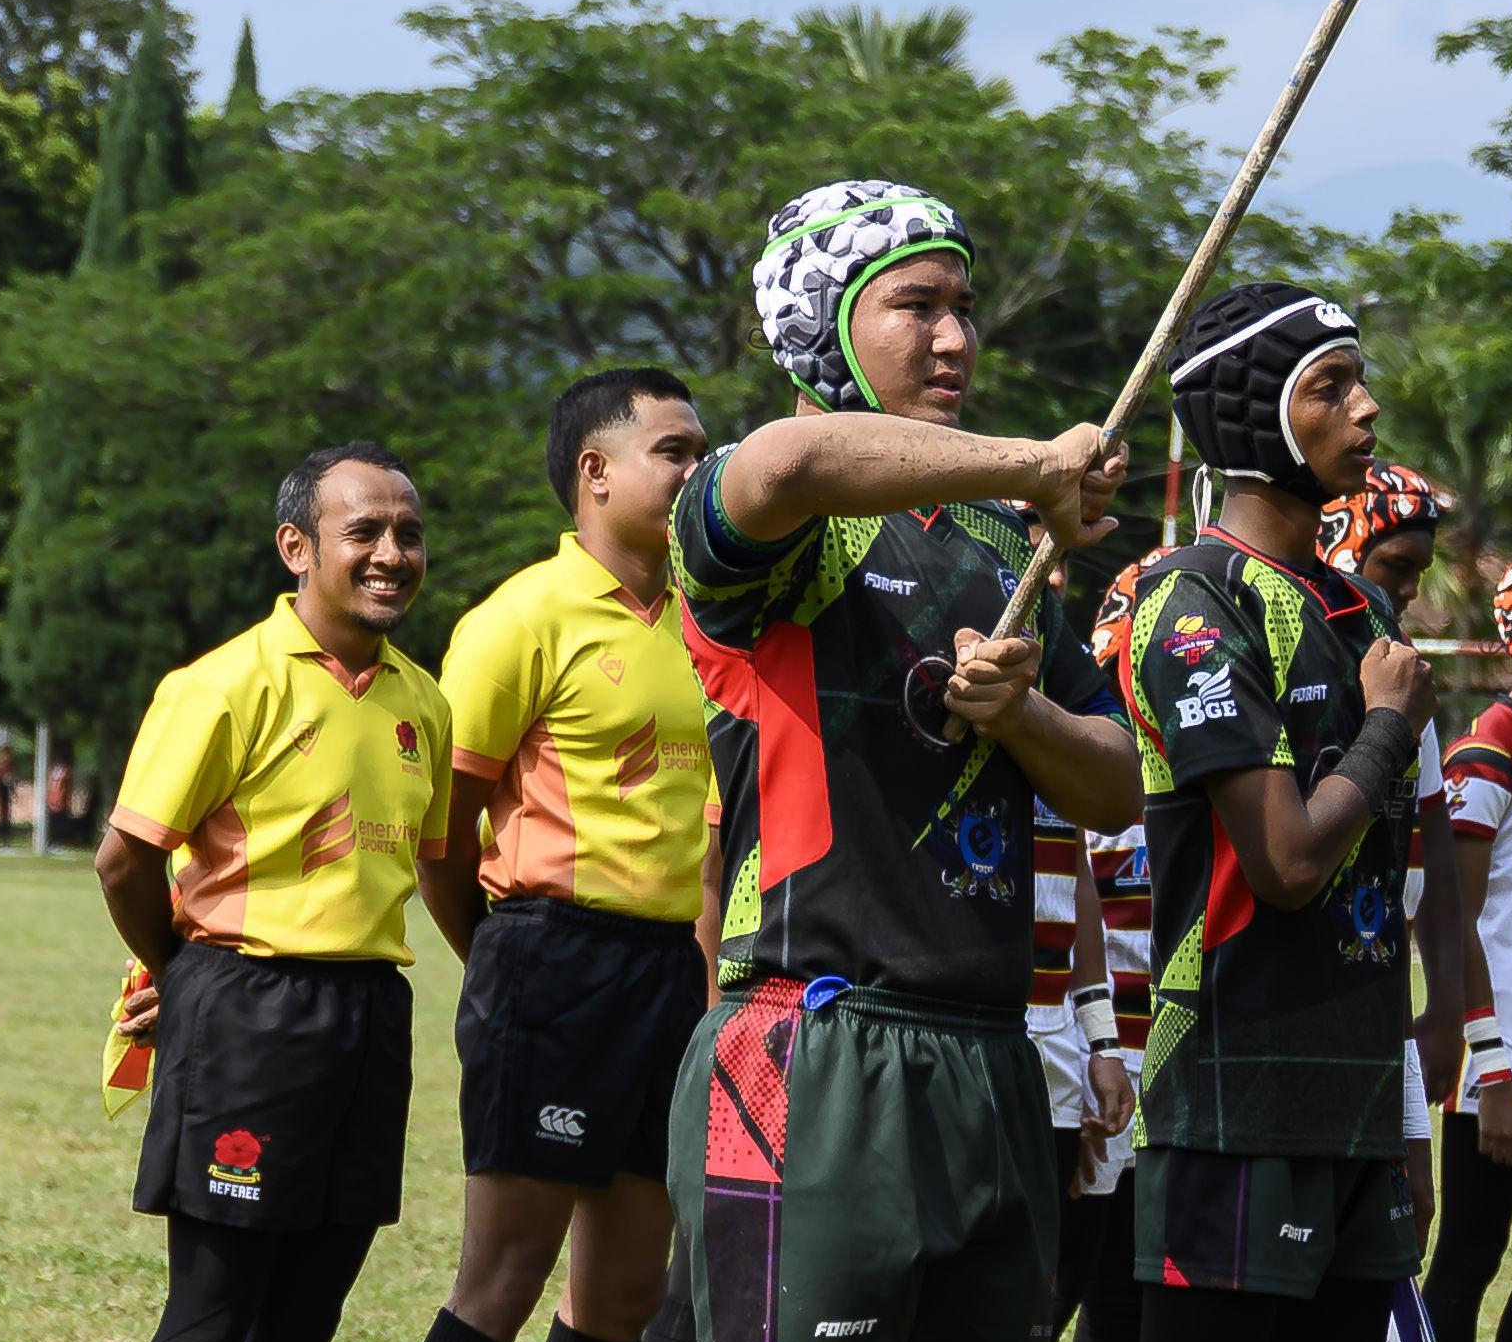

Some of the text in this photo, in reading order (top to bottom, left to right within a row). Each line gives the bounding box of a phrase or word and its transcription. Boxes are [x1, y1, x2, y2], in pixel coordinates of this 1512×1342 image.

[1175, 697, 1238, 729] BGE
[360, 837, 397, 855] SPORTS
[535, 1129, 584, 1147] canterbury
[209, 1178, 261, 1201] REFEREE
[814, 1318, 881, 1338] FORFIT
